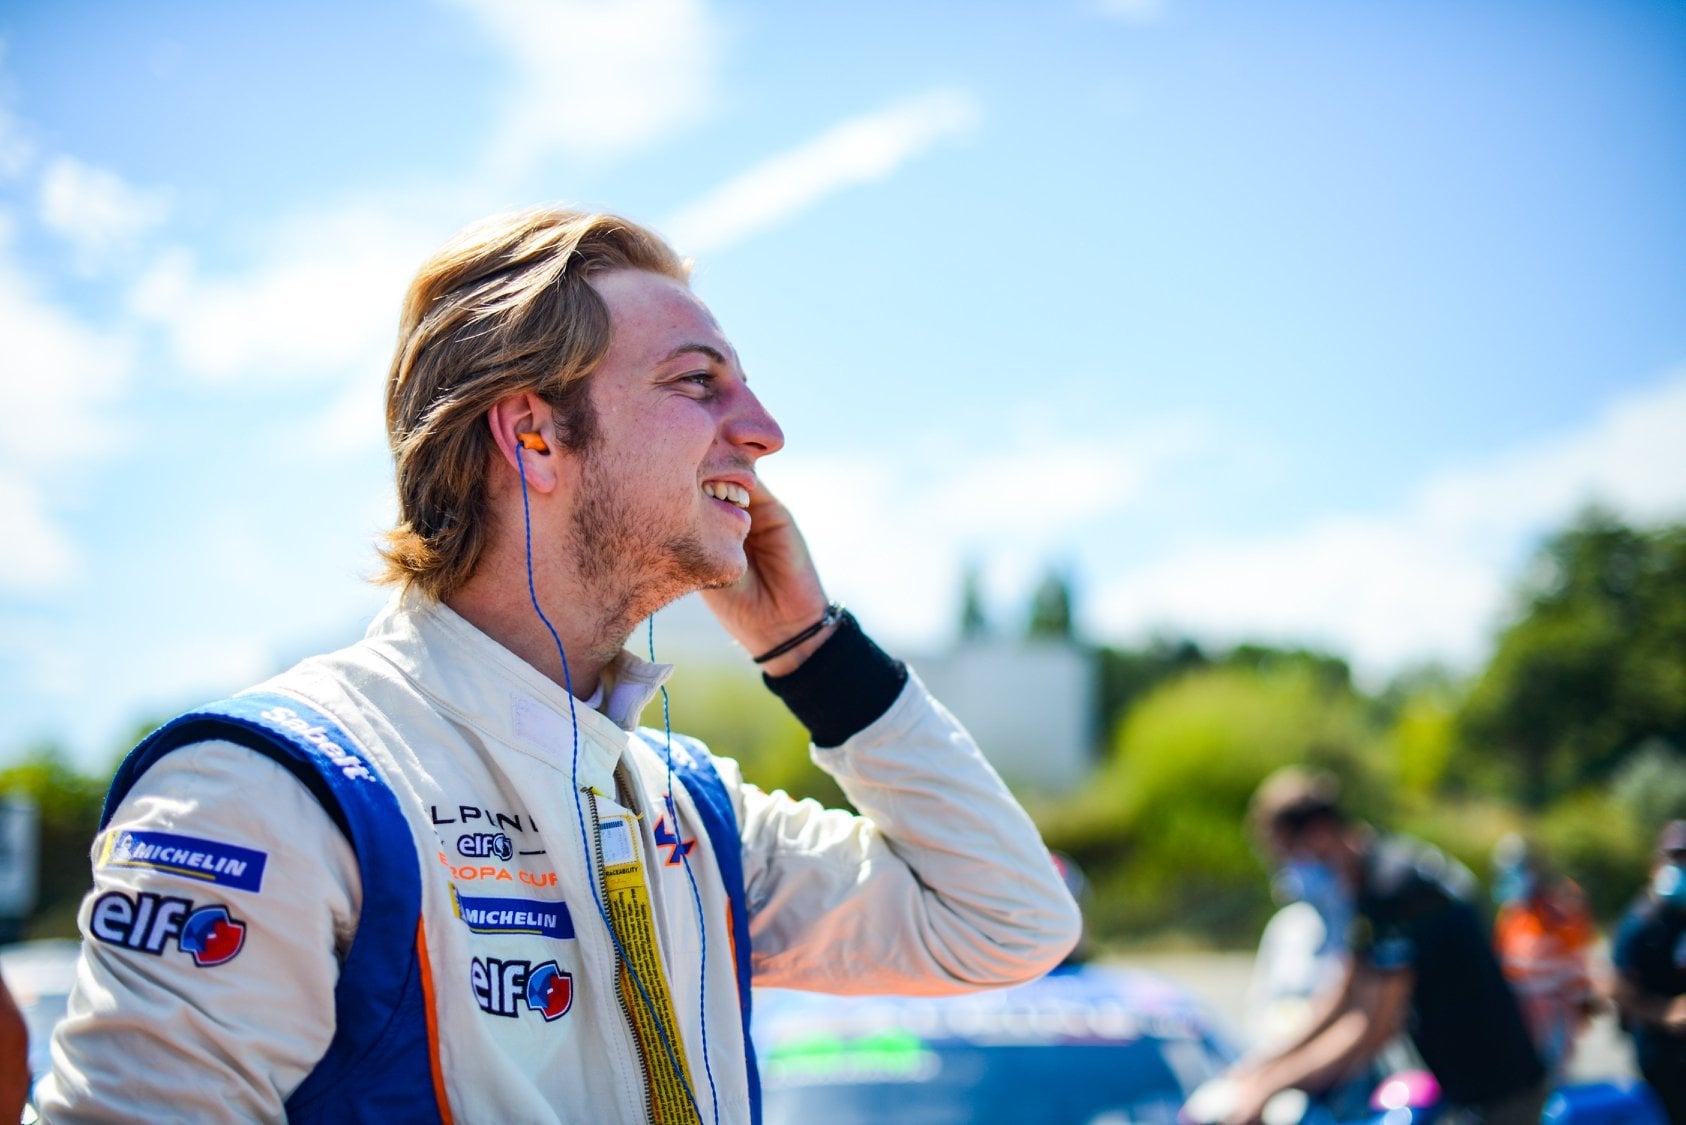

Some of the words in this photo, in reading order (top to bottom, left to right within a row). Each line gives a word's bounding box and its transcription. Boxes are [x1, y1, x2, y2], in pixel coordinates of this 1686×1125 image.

[133, 841, 247, 876] MICHELIN
[457, 833, 493, 857] elf
[90, 891, 193, 956] elf
[465, 907, 556, 928] MICHELIN
[471, 956, 531, 1018] elf
